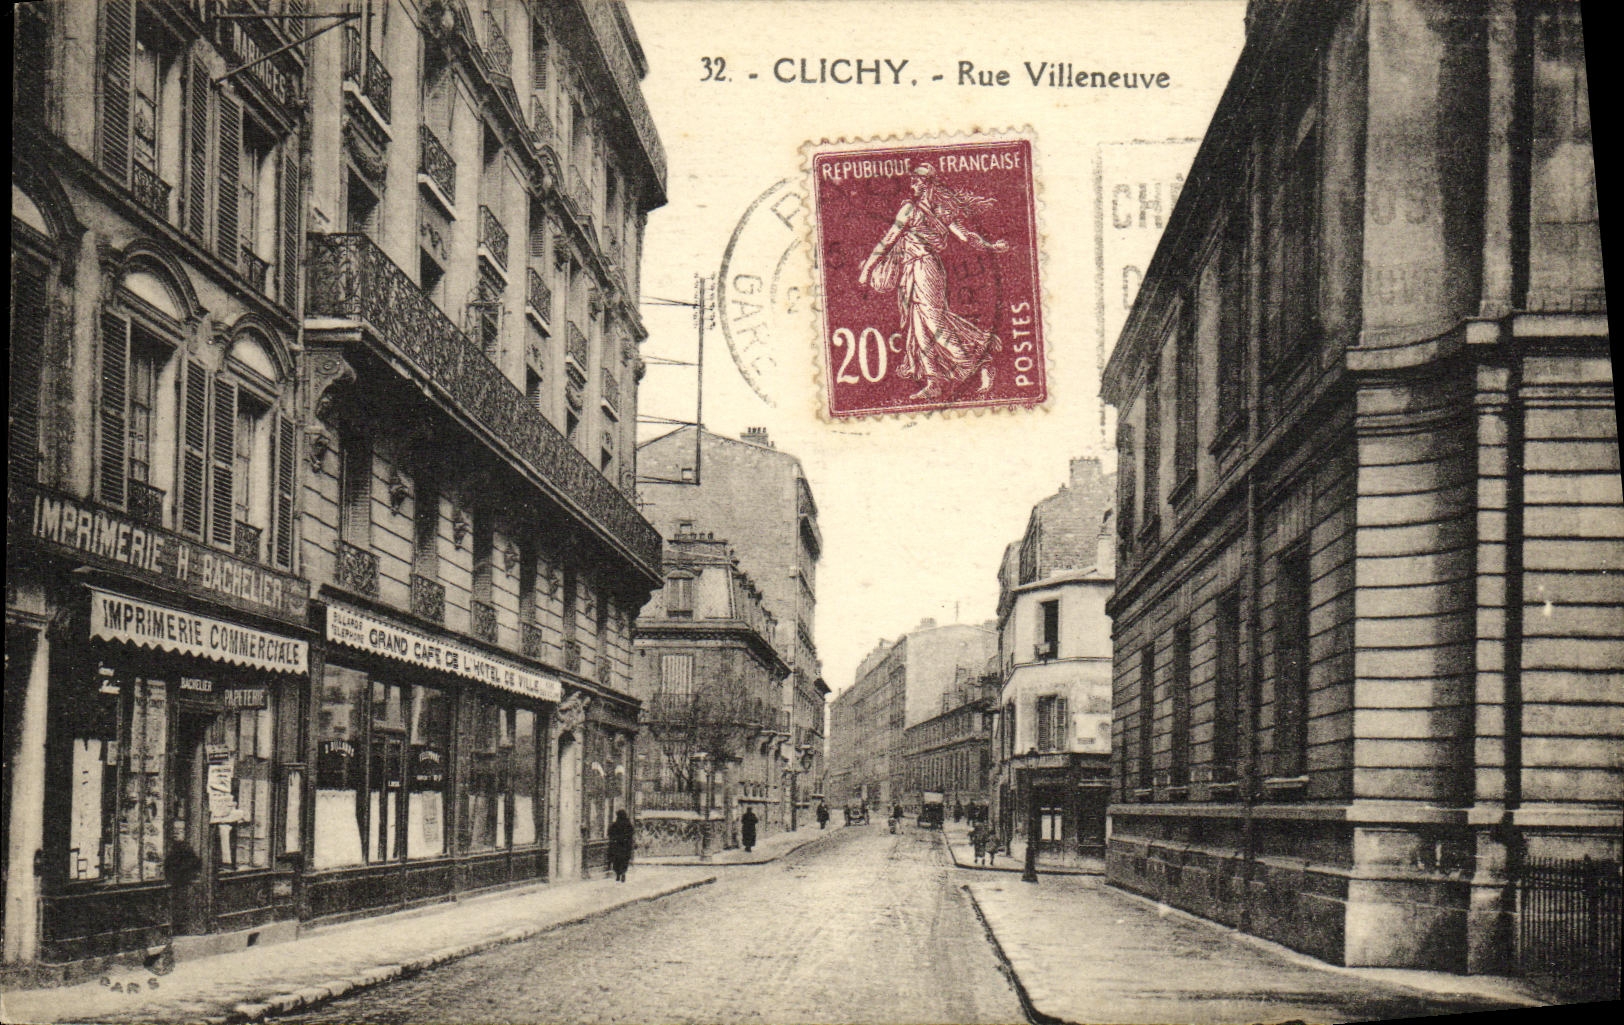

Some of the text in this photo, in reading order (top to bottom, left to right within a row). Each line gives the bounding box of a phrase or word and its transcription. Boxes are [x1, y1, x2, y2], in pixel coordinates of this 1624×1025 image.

[939, 151, 1021, 172] FRANÇAISE
[1010, 301, 1035, 389] POSTES
[33, 494, 165, 575] IMPRIMERIE
[202, 553, 284, 612] BACHELIER
[102, 598, 301, 667] IMPRIMERIE COMMERCIALE
[368, 628, 409, 656] GRAND
[518, 674, 540, 694] VILLE
[180, 676, 213, 693] BACHELIER
[224, 689, 266, 708] PAPETERIE
